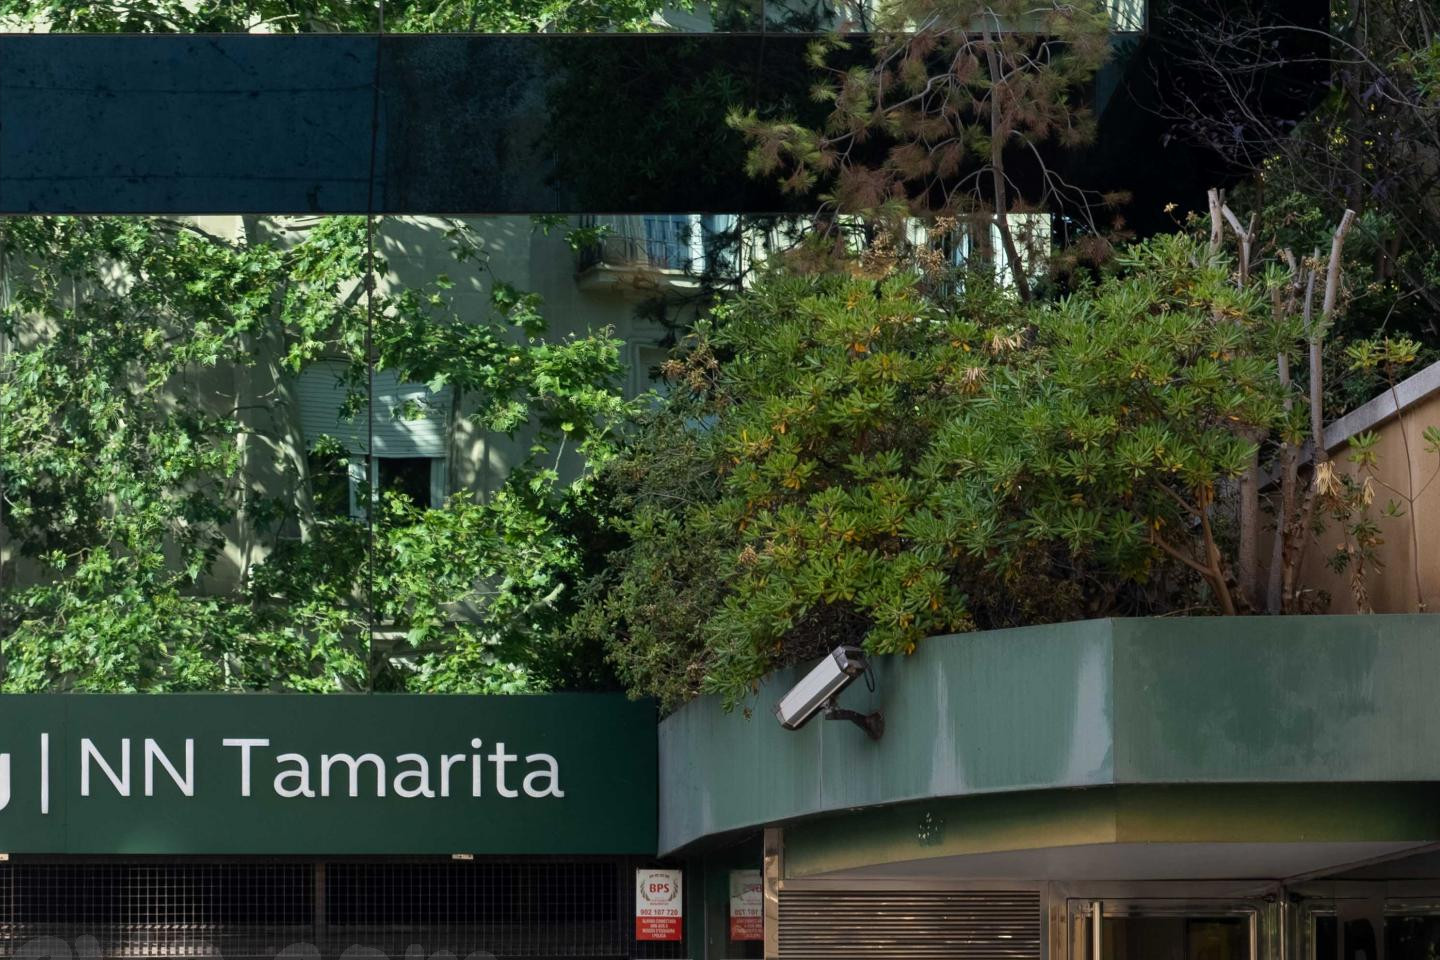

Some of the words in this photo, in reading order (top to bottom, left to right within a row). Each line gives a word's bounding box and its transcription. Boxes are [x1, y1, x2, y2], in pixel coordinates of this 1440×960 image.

[80, 738, 195, 796] NN
[222, 738, 565, 798] Tamarita
[649, 883, 670, 893] BPS
